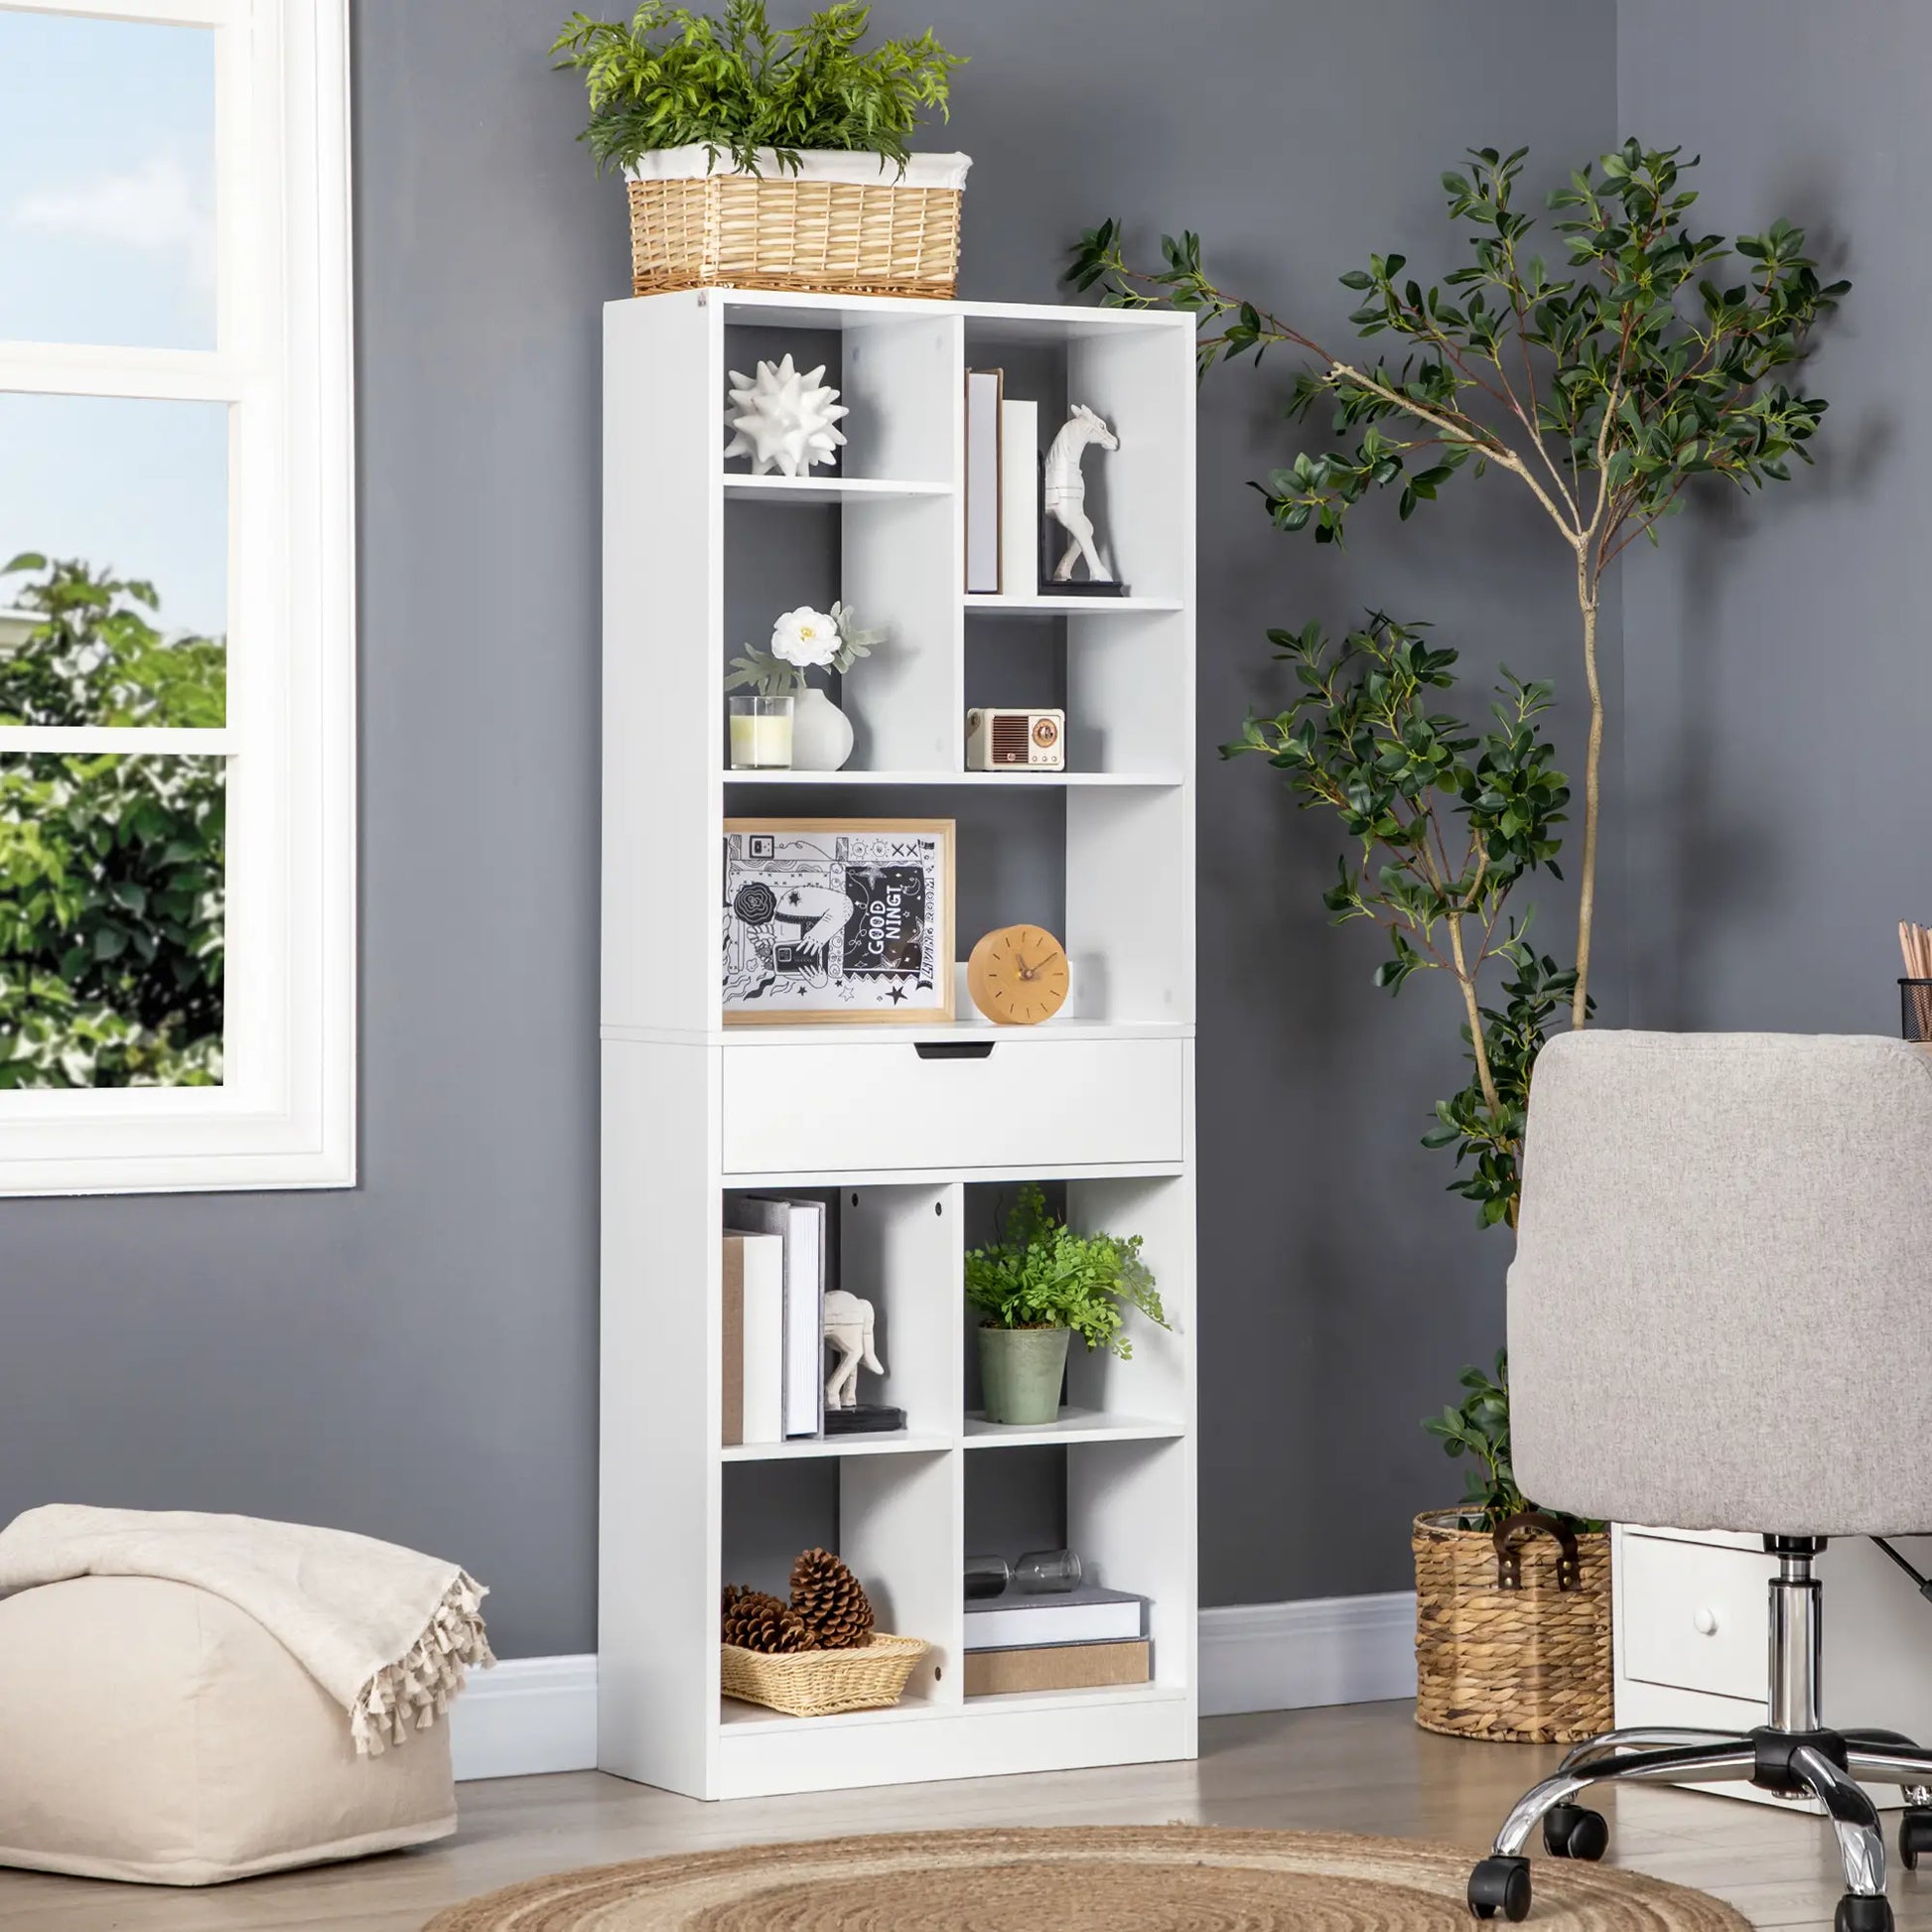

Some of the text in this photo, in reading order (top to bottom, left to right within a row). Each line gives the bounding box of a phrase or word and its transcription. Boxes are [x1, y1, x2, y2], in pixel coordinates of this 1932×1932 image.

[868, 900, 886, 954] GOOD
[886, 886, 901, 939] NINGT
[921, 878, 934, 979] LIVING ROOM
